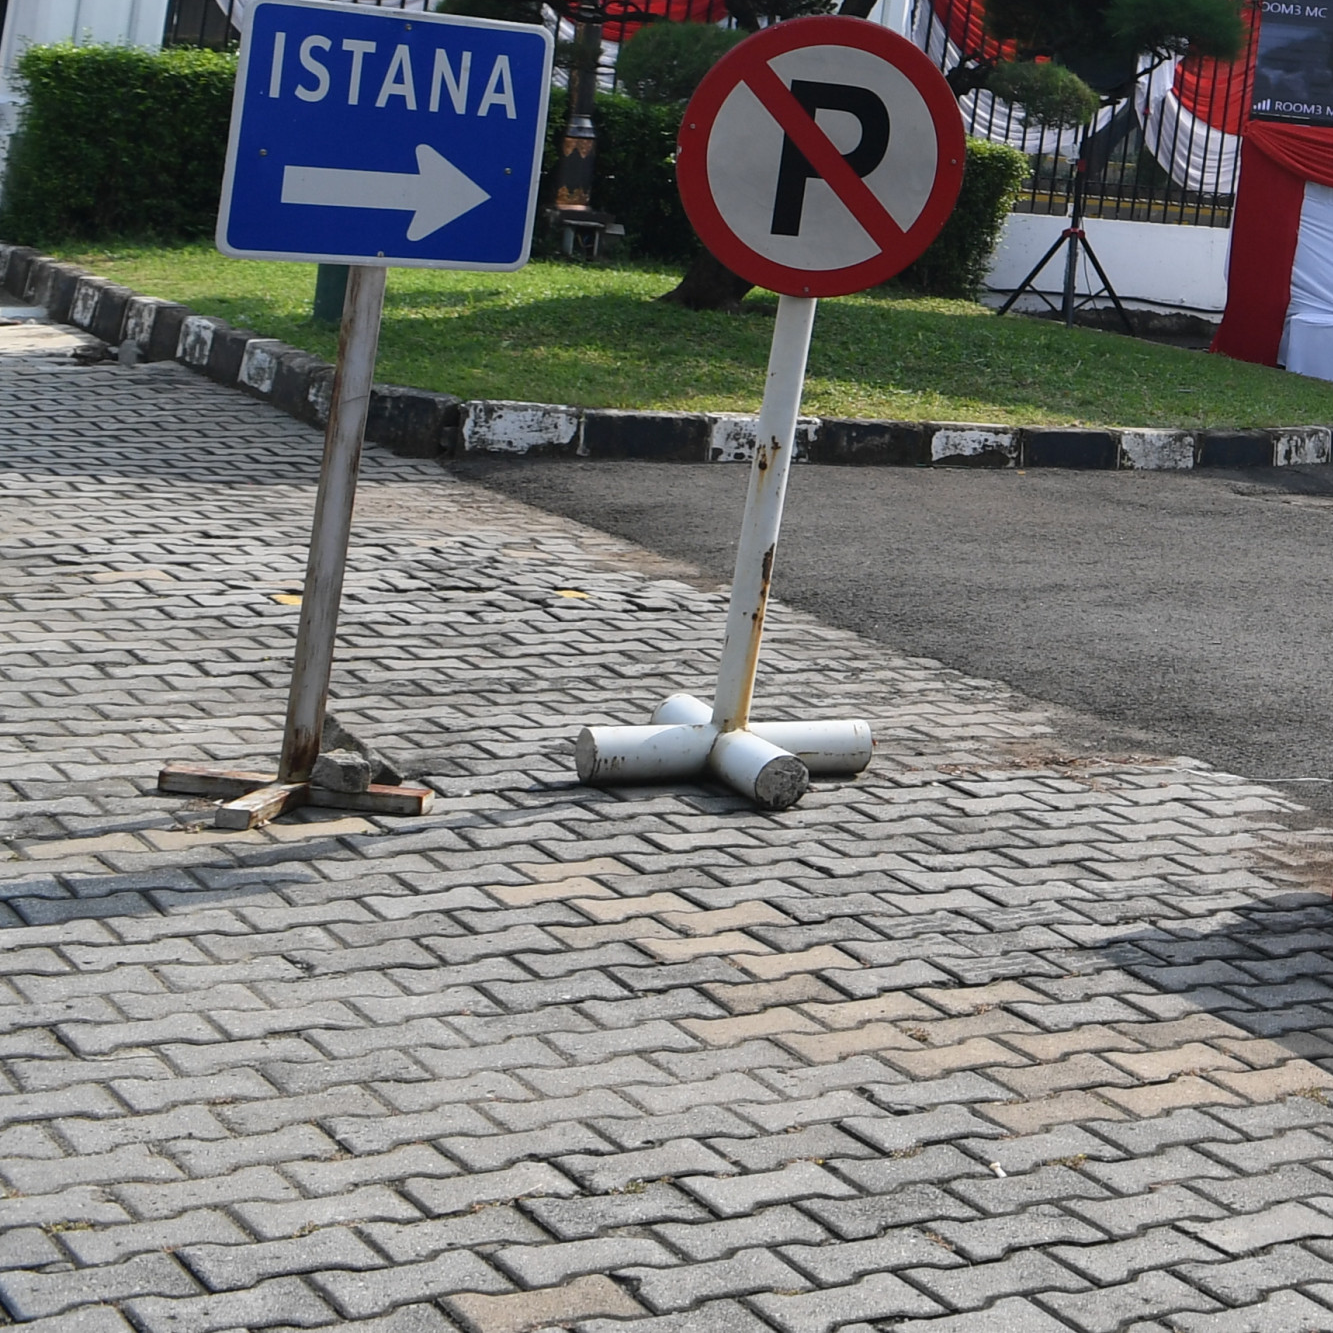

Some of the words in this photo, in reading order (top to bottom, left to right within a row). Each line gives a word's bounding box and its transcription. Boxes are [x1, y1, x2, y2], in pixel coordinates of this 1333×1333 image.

[1261, 1, 1302, 16] OOM3
[1305, 6, 1328, 19] MC
[268, 31, 518, 120] ISTANA
[1274, 100, 1323, 116] ROOM3
[769, 79, 891, 237] P
